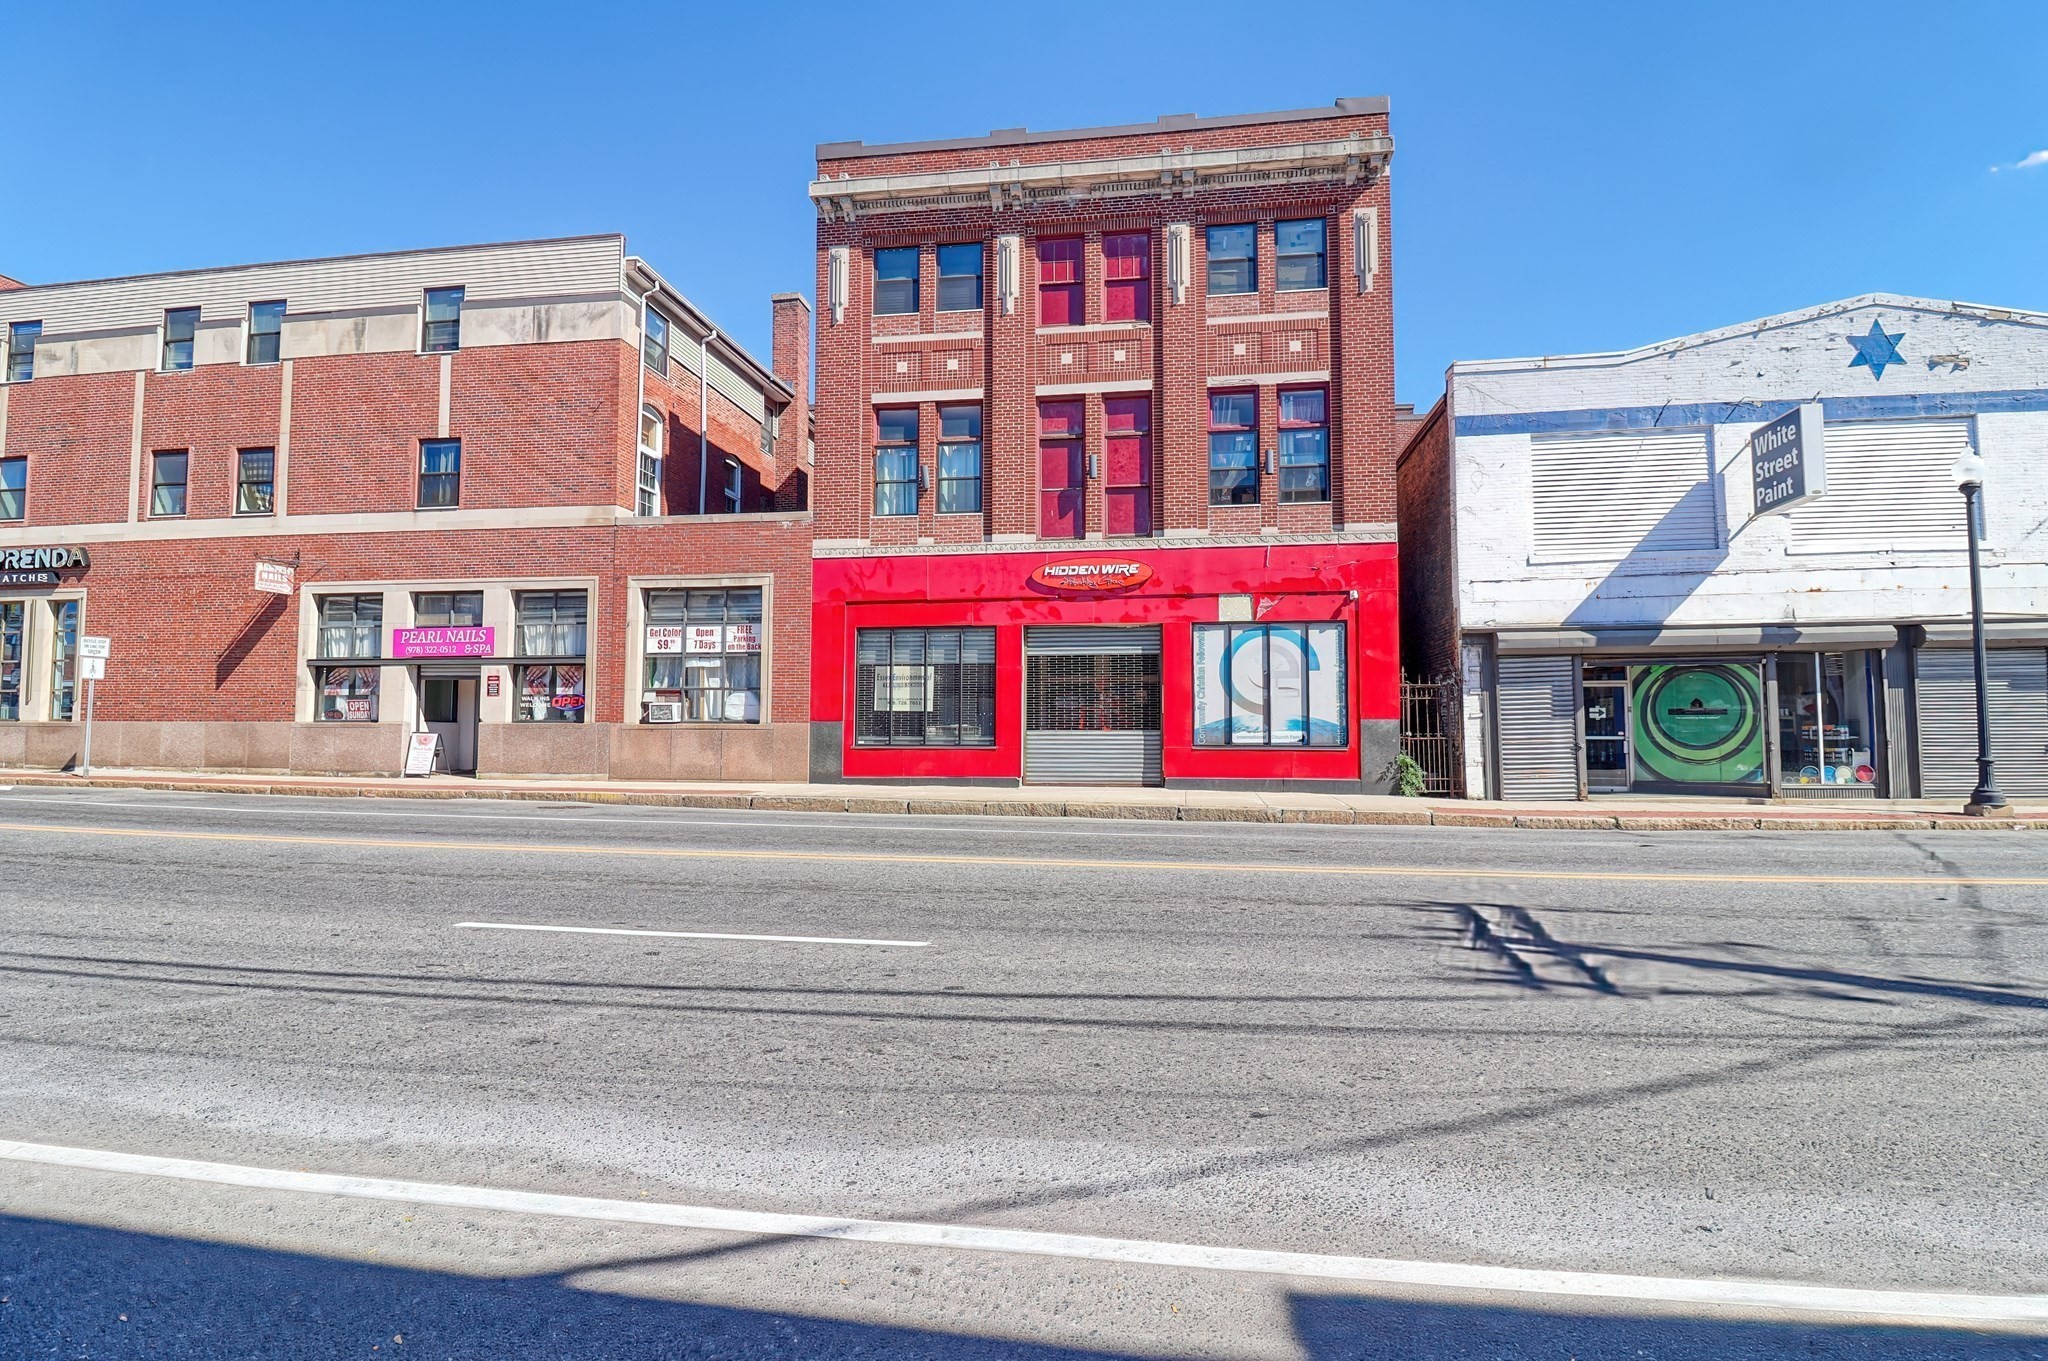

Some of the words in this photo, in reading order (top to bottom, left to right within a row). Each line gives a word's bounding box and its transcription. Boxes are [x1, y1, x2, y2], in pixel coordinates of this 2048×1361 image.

[1754, 424, 1796, 456] White
[1755, 447, 1799, 482] Street
[1756, 477, 1794, 507] Paint
[1044, 565, 1100, 576] HIDDEN
[1102, 563, 1140, 576] WIRE
[0, 573, 48, 583] ATCHES
[261, 571, 288, 584] NAILS
[650, 628, 661, 637] Gel
[663, 627, 683, 638] Color
[695, 627, 714, 638] Open
[737, 625, 753, 634] FREE
[400, 630, 443, 644] PEARL
[446, 629, 487, 643] NAILS
[733, 635, 756, 644] Parking
[405, 645, 423, 655] (978)
[424, 645, 457, 654] 322-0512
[694, 640, 698, 649] 7
[699, 640, 716, 650] Days
[736, 643, 746, 651] the
[746, 643, 762, 651] Back
[1197, 626, 1206, 666] Fellowship
[1197, 667, 1206, 700] Christian
[349, 701, 370, 711] OPEN
[552, 696, 585, 708] OPEN
[349, 710, 372, 719] SUNDAY
[1197, 701, 1207, 745] Community
